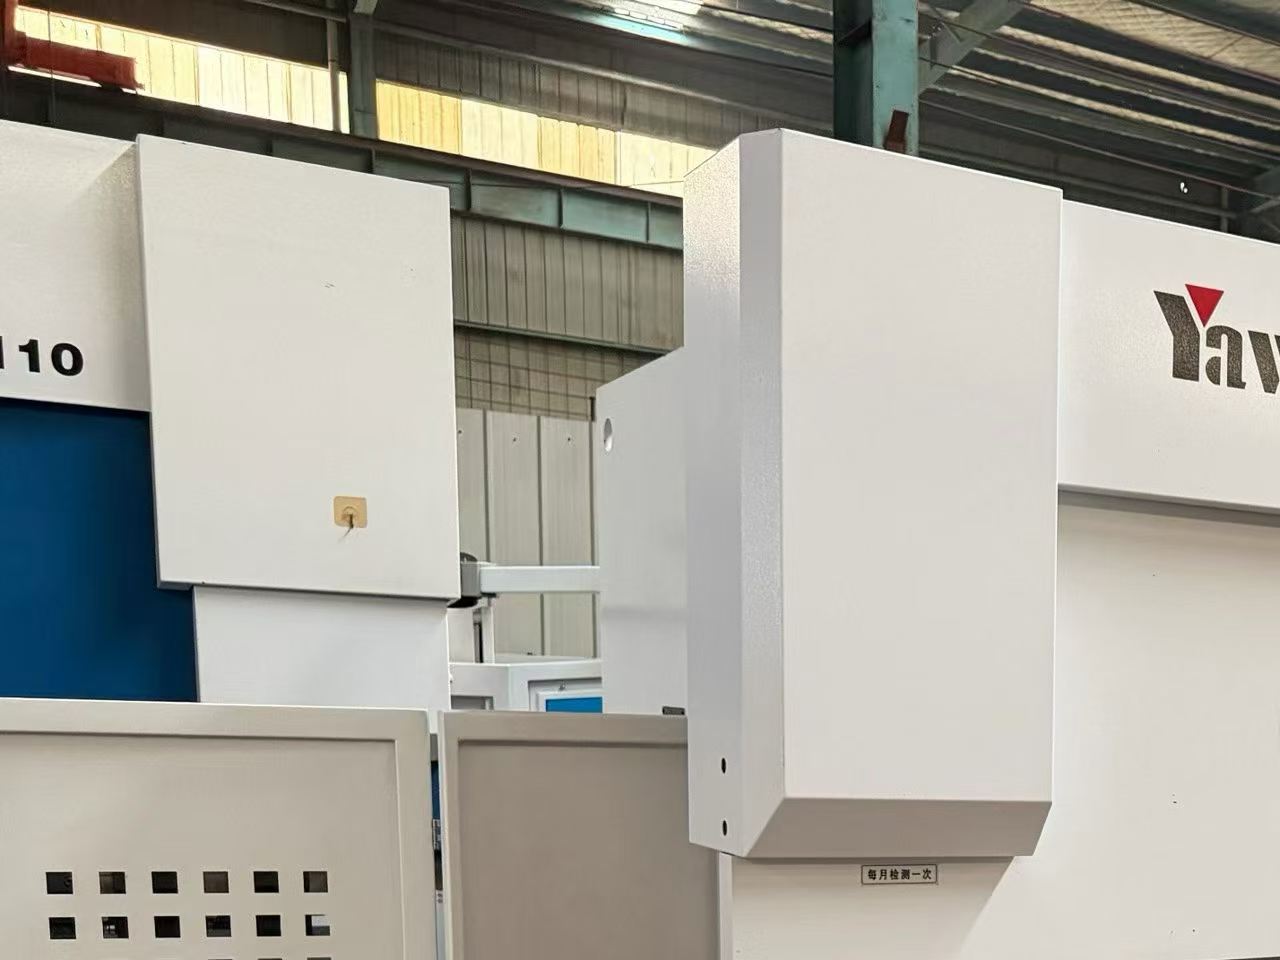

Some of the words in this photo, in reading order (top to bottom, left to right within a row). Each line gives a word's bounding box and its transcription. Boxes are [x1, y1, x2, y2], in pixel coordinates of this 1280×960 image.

[0, 335, 84, 377] 10
[867, 867, 933, 881] 每月检测一次
